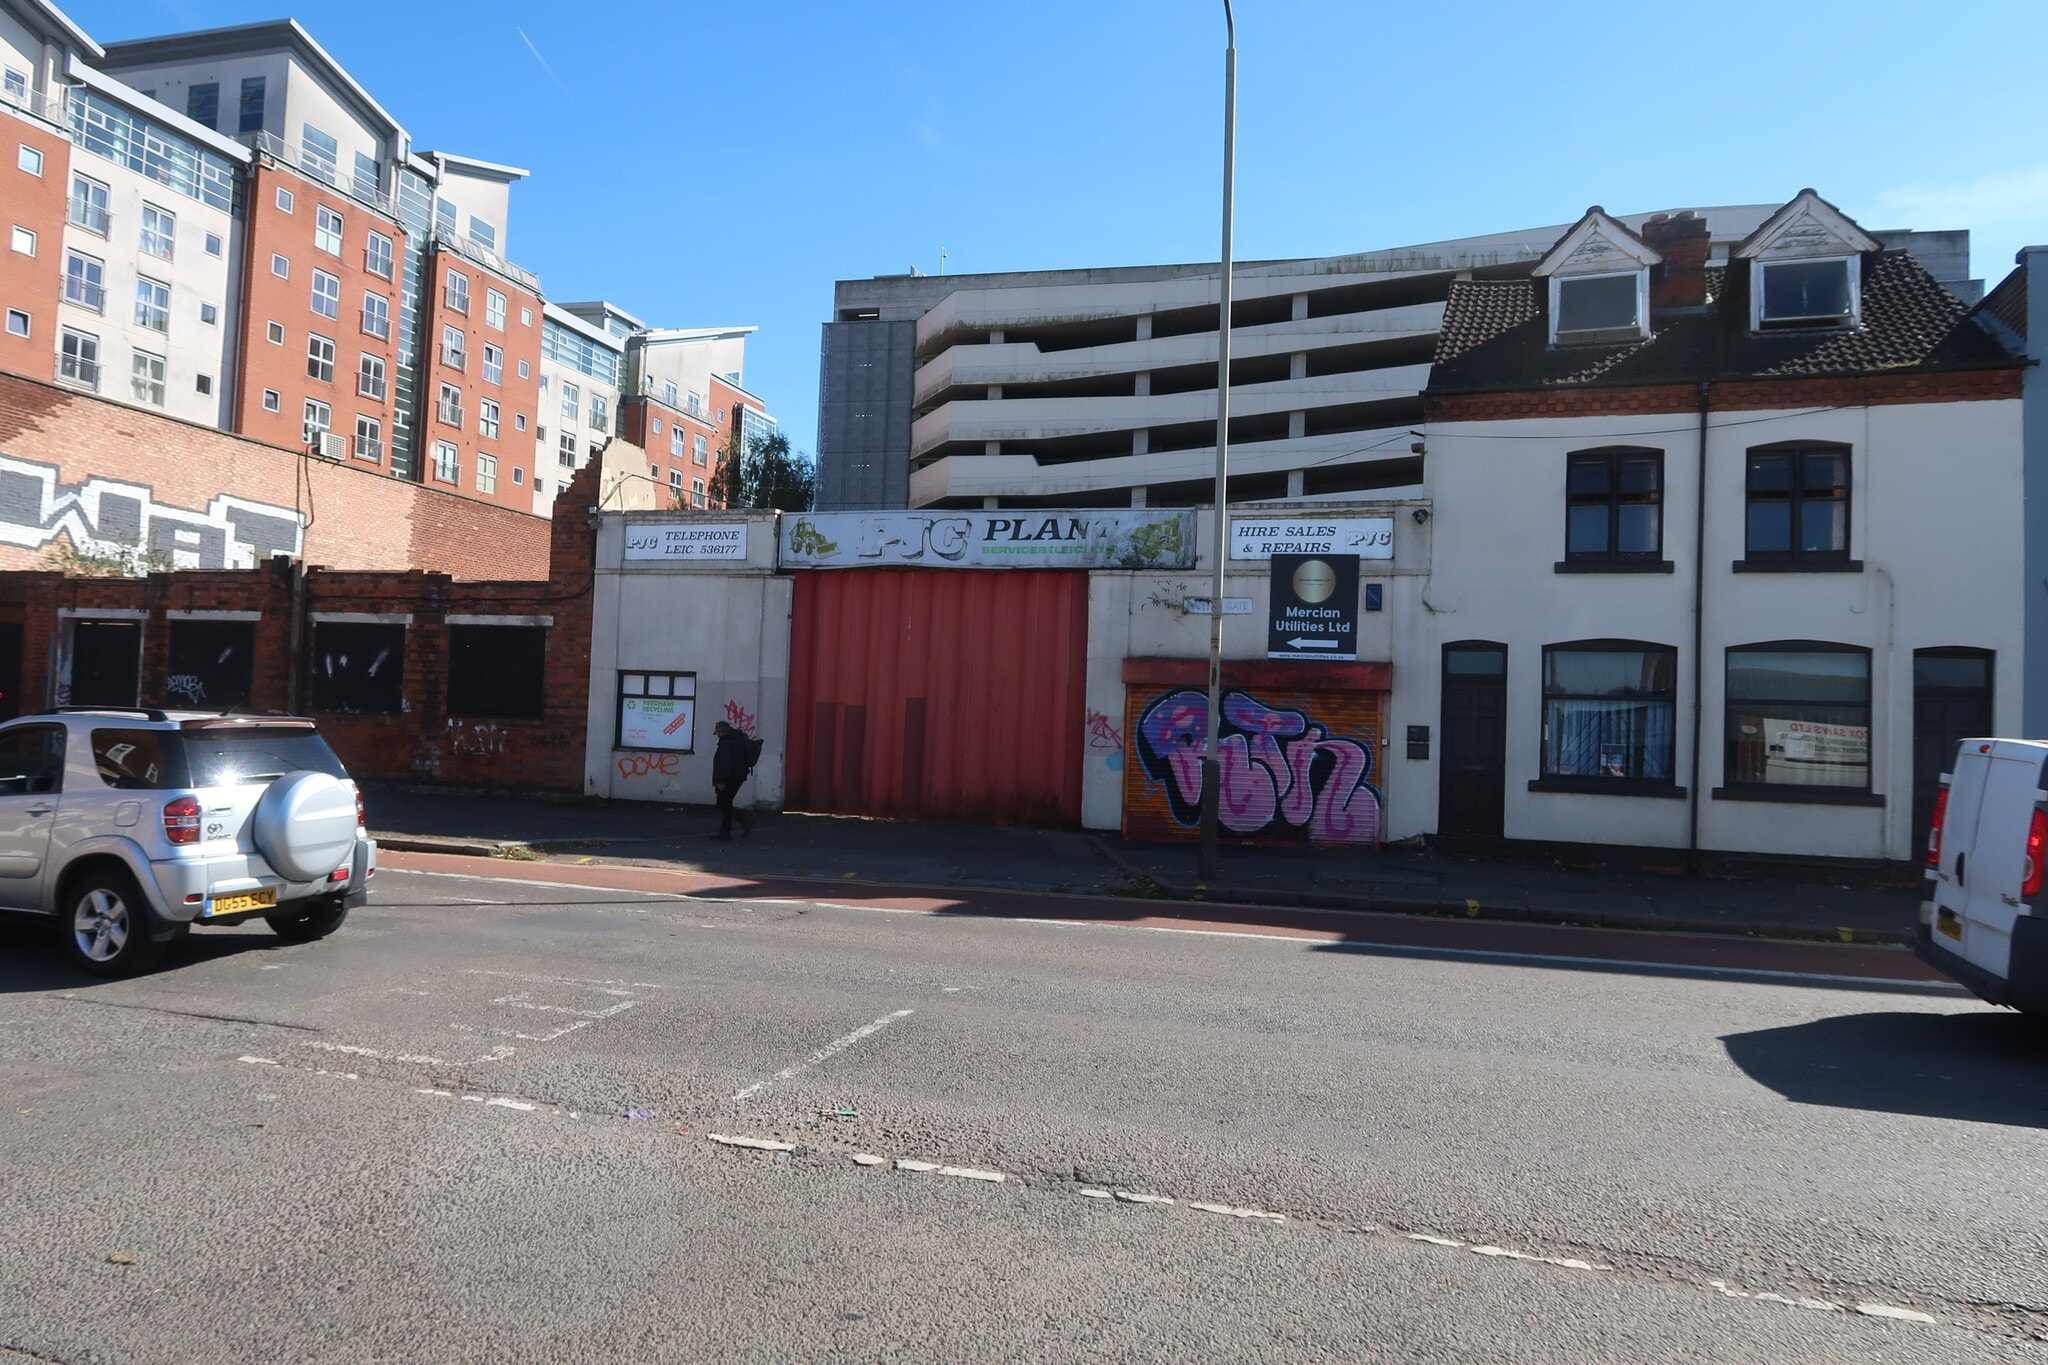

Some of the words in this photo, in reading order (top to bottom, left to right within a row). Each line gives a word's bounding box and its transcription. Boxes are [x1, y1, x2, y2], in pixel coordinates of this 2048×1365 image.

[665, 531, 740, 540] TELEPHONE
[1238, 526, 1280, 537] HIRE
[1285, 526, 1337, 537] SALES
[626, 536, 658, 549] PJC
[1349, 531, 1392, 546] PJC
[664, 545, 695, 554] LEIC.
[700, 545, 738, 554] 536177
[982, 546, 1048, 554] SERVICES
[1243, 544, 1254, 553] &
[1260, 543, 1331, 553] REPAIRS
[1286, 606, 1340, 618] Mercian
[1276, 620, 1324, 632] Utilities
[1329, 621, 1350, 633] Ltd
[643, 706, 675, 714] RECYCLING
[214, 895, 248, 912] DG55
